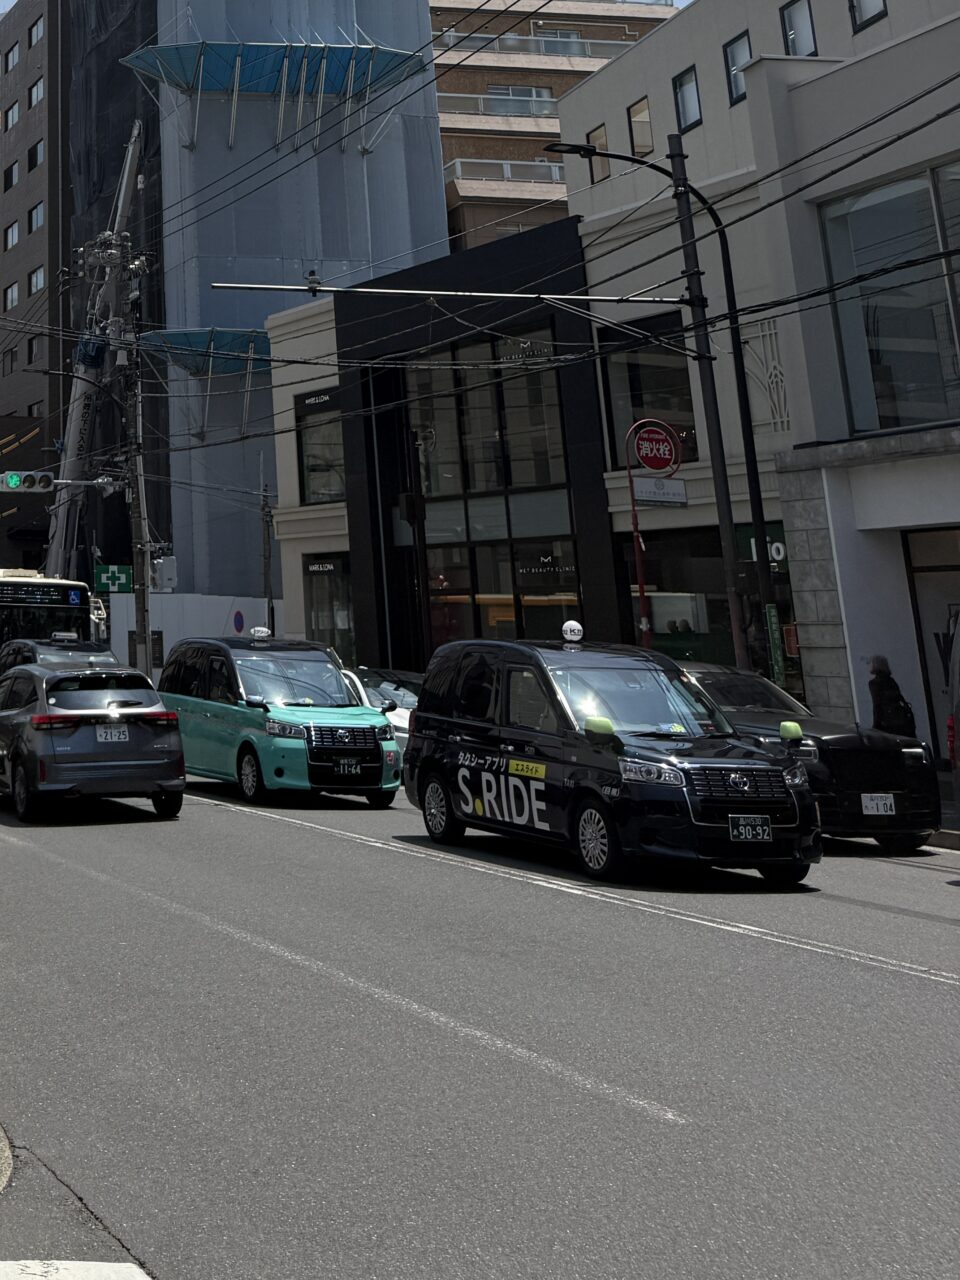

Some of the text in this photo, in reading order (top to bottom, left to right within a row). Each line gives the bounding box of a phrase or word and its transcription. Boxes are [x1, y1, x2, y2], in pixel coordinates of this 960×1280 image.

[639, 441, 672, 459] 消火栓
[103, 730, 128, 740] 21-25
[458, 751, 540, 775] タクシーアプリ エスライド
[458, 768, 550, 831] S.RIDE
[739, 825, 770, 839] 90-92
